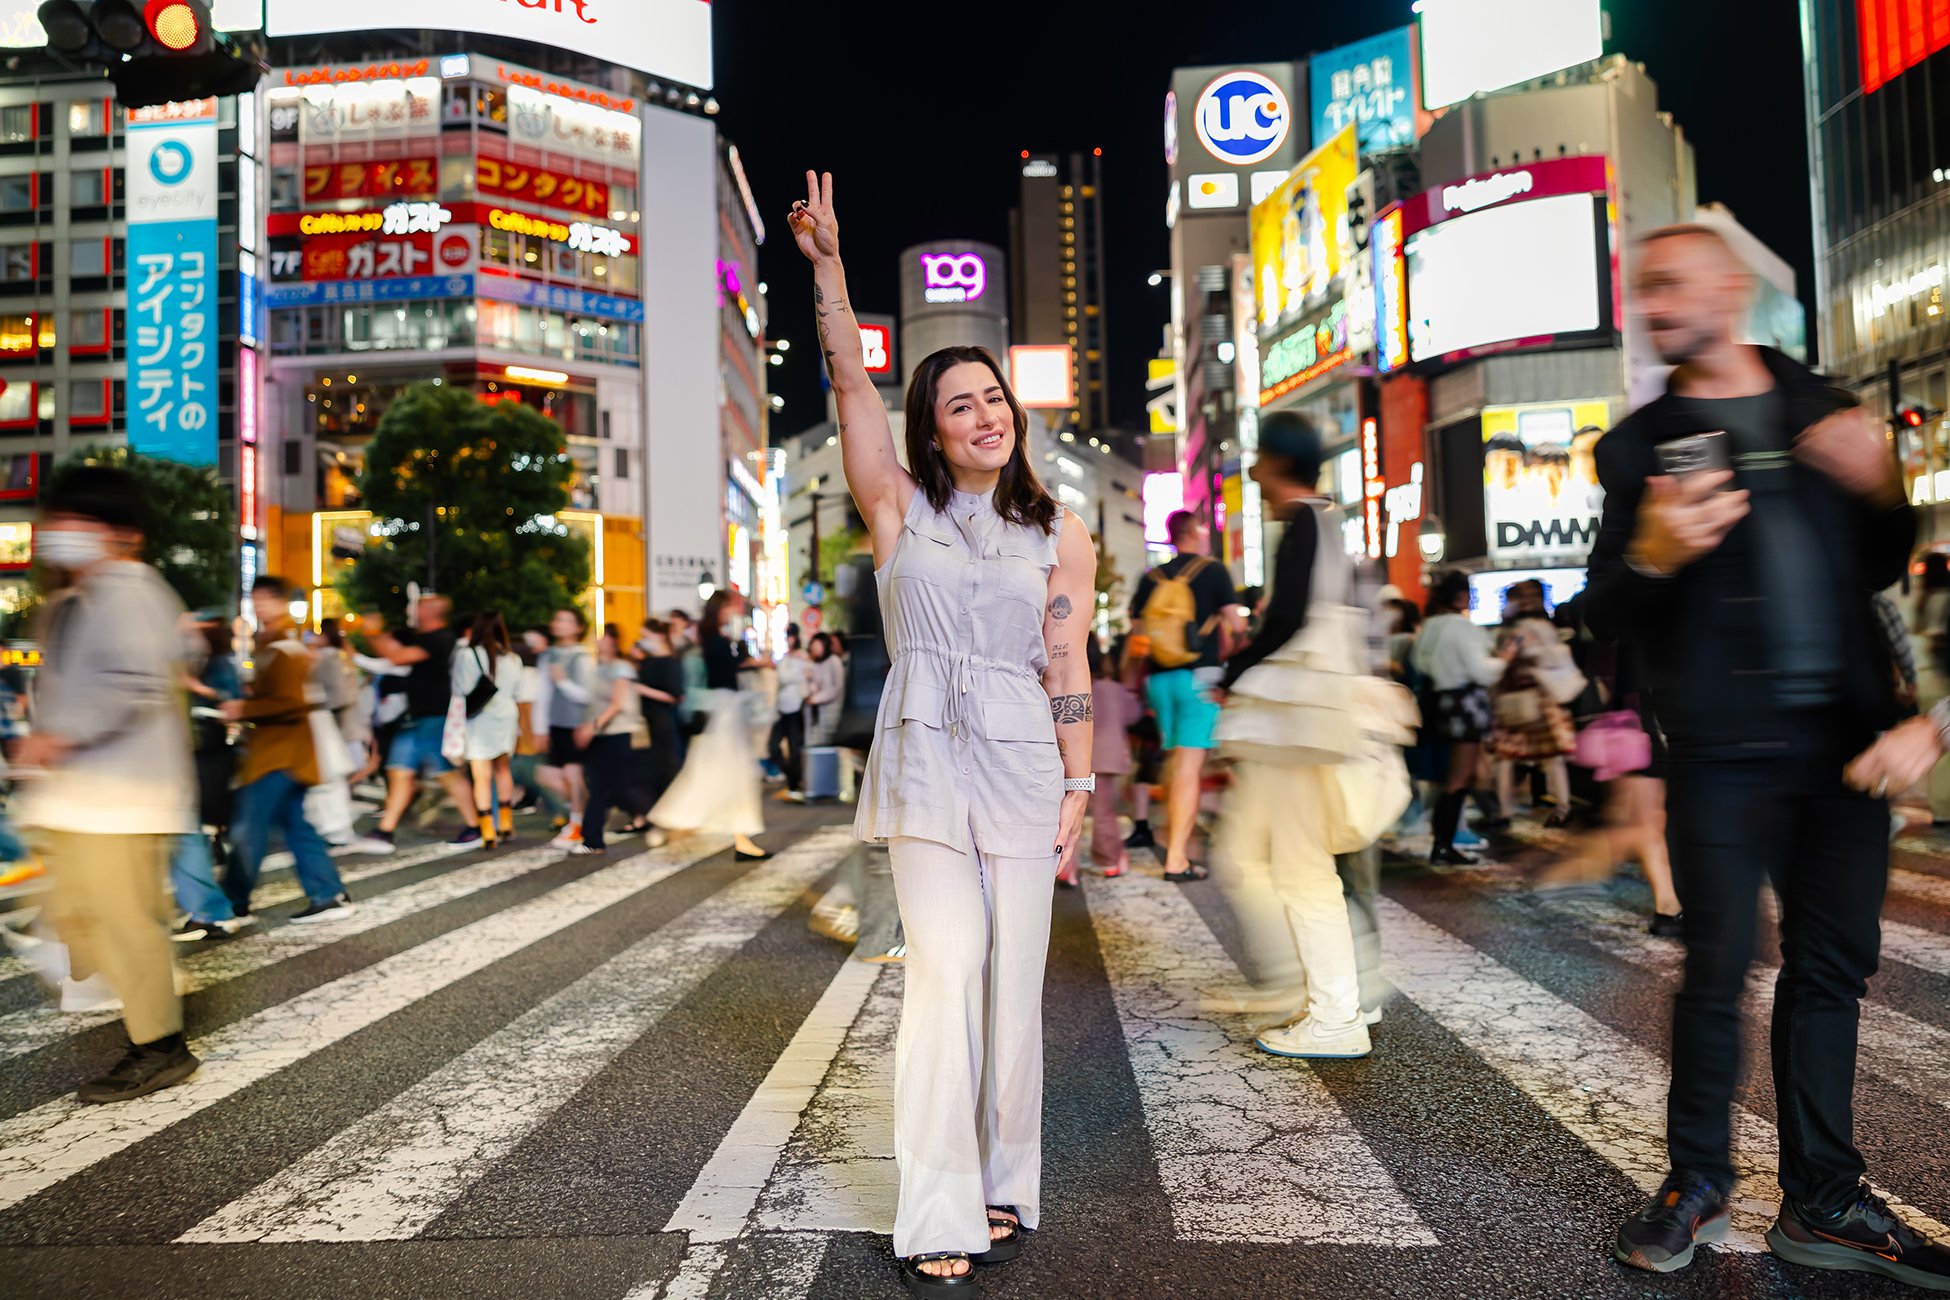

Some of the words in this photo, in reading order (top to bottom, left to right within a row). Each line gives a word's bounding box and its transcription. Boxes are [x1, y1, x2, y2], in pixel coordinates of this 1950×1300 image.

[477, 158, 604, 209] コンタクト
[346, 240, 429, 279] ガスト
[920, 252, 987, 301] 109
[137, 253, 174, 432] アイシティ
[180, 251, 207, 431] コンタクトの
